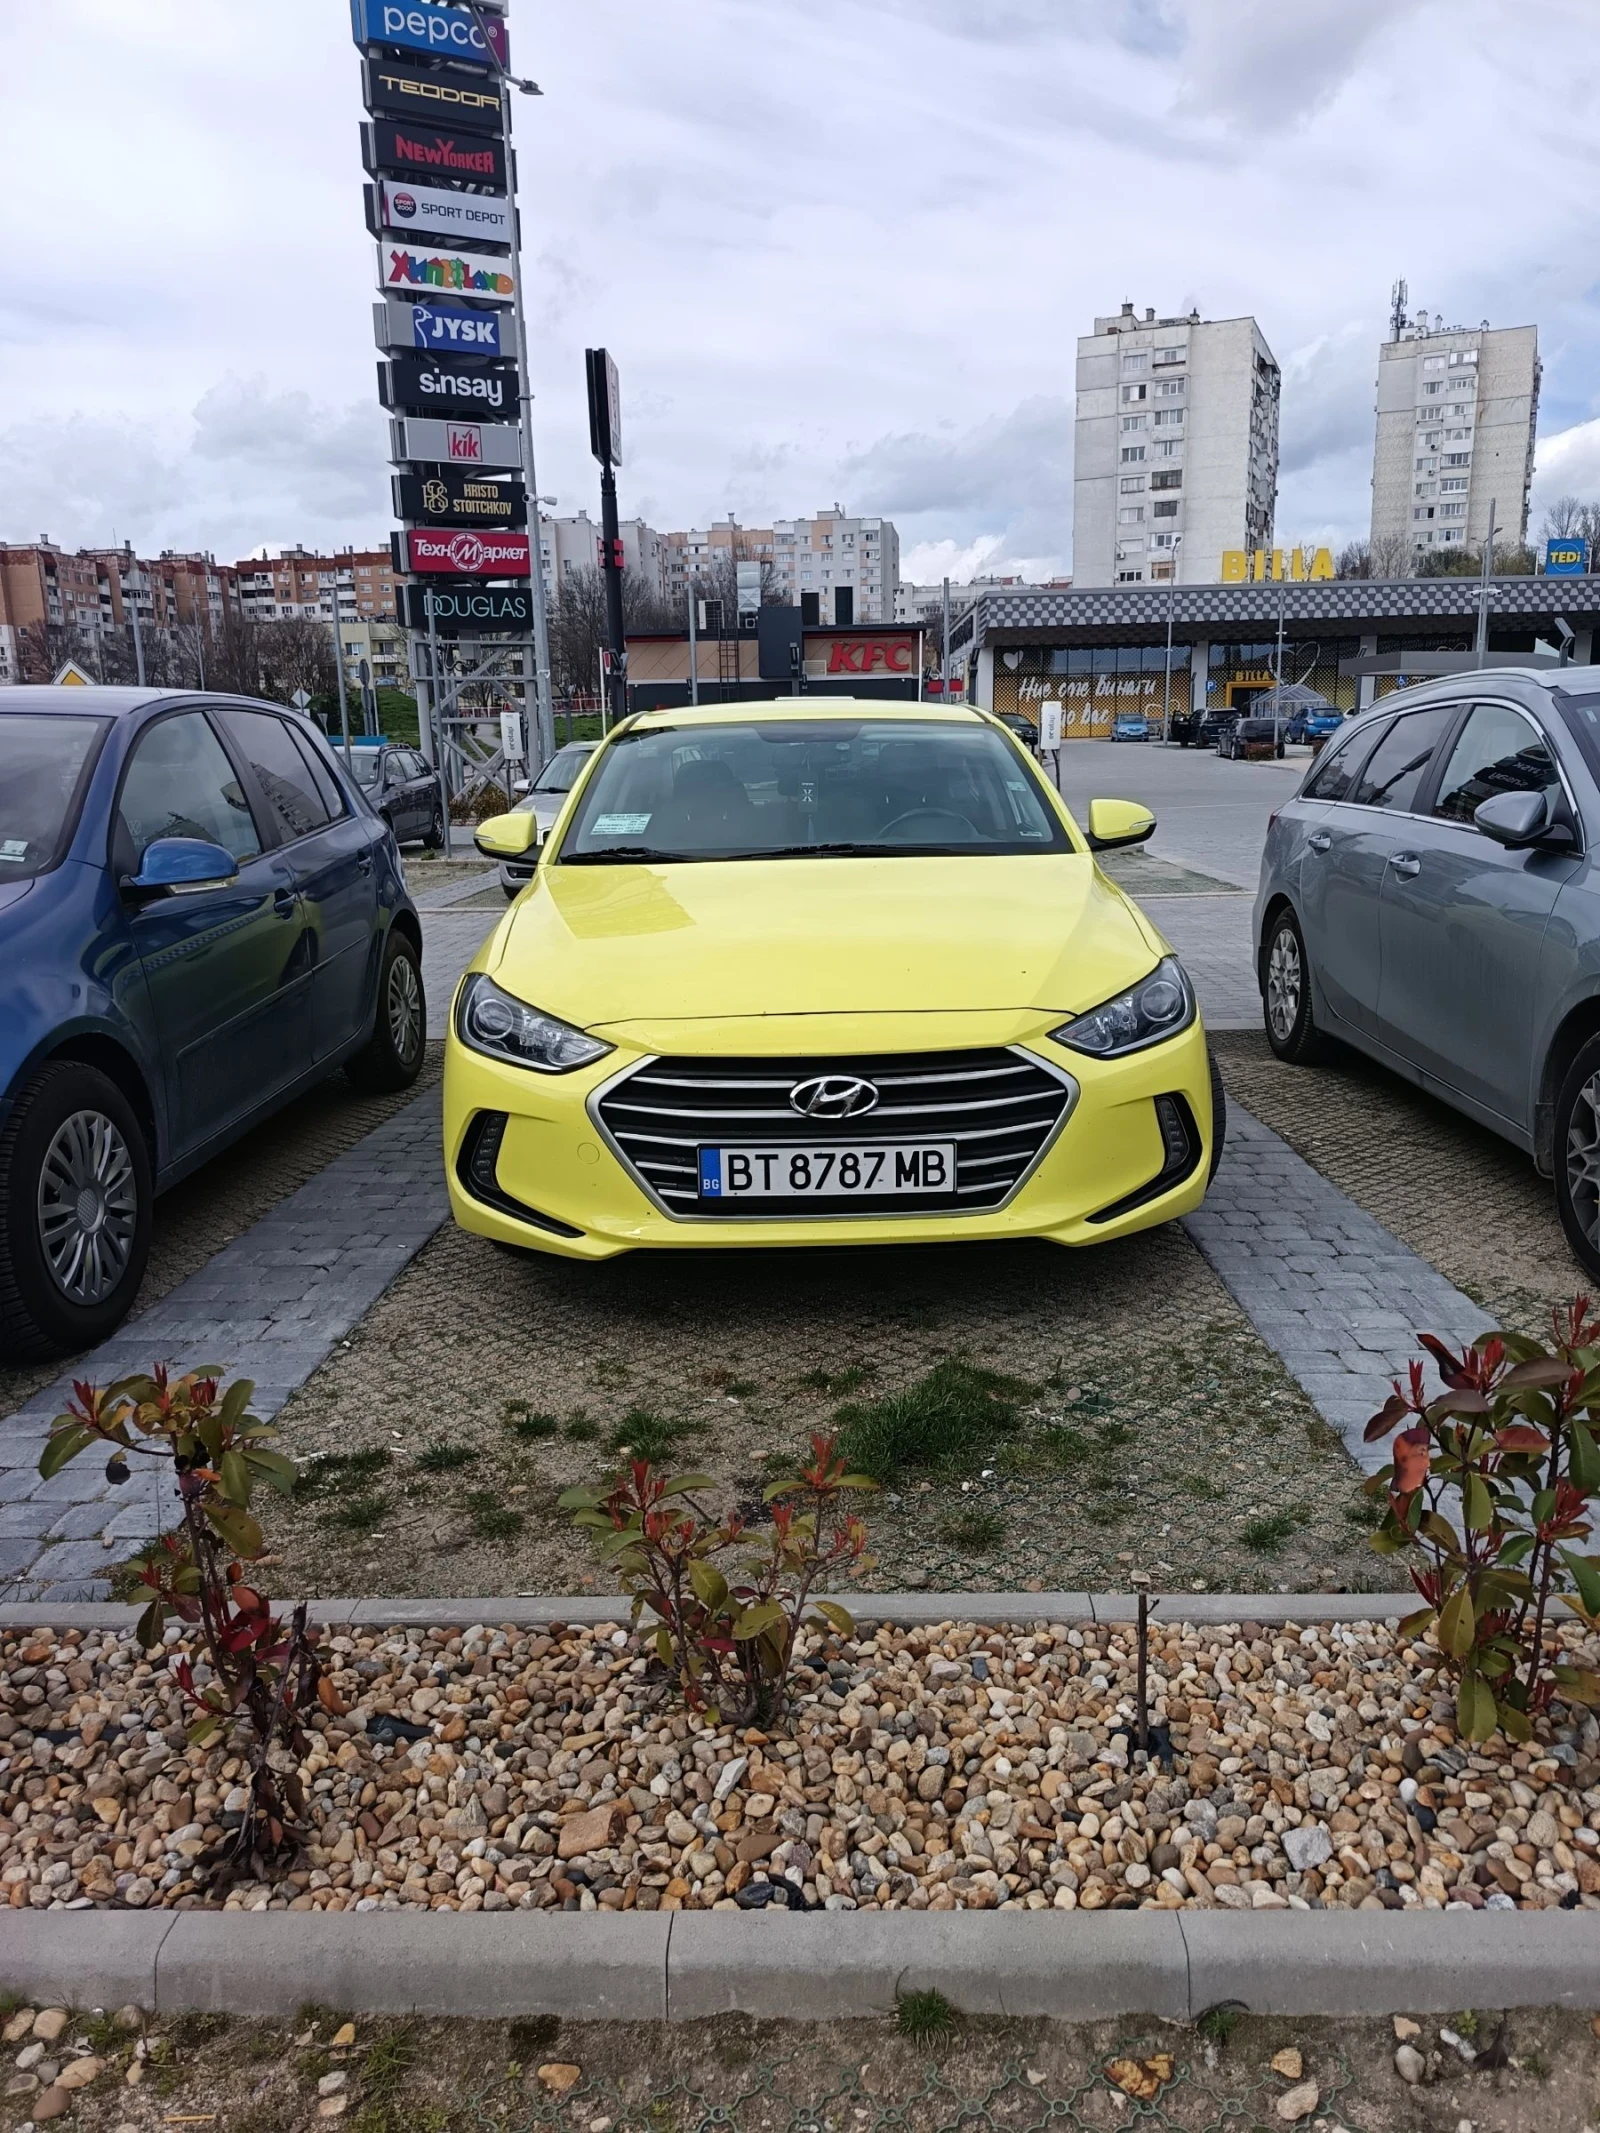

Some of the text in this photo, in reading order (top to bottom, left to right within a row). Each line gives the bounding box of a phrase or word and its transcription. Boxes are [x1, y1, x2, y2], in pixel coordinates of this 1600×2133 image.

[384, 6, 487, 49] pepco
[378, 75, 501, 112] TEODOR
[394, 198, 415, 207] SPORT
[396, 204, 413, 213] 2000
[421, 202, 506, 226] SPORT DEPOT
[432, 317, 497, 344] JYSK
[419, 367, 503, 407] sinsay
[464, 484, 499, 499] HRISTO
[453, 499, 512, 515] STOITCHKOV
[1222, 548, 1335, 582] BILLA
[1550, 551, 1581, 564] TEDi
[423, 594, 527, 619] DOUGLAS
[827, 640, 911, 672] KFC
[1236, 670, 1271, 681] BILLA
[727, 1150, 947, 1191] BT 8787 MB
[703, 1178, 720, 1190] BG
